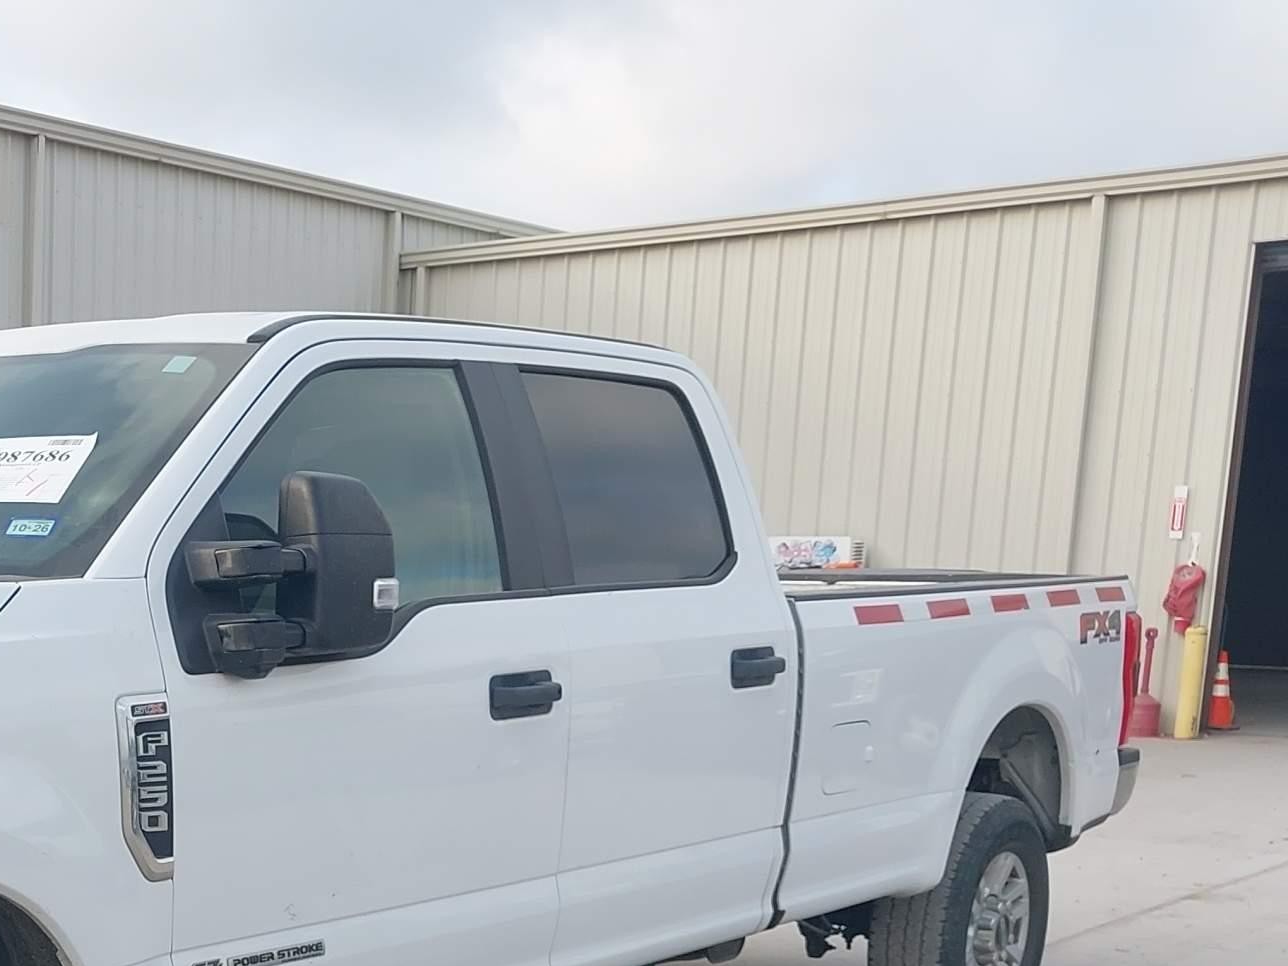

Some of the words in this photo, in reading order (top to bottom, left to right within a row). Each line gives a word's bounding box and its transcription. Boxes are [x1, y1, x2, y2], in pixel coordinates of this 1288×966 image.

[1080, 609, 1121, 644] FX4
[137, 730, 169, 833] F250
[276, 941, 324, 960] STROKE
